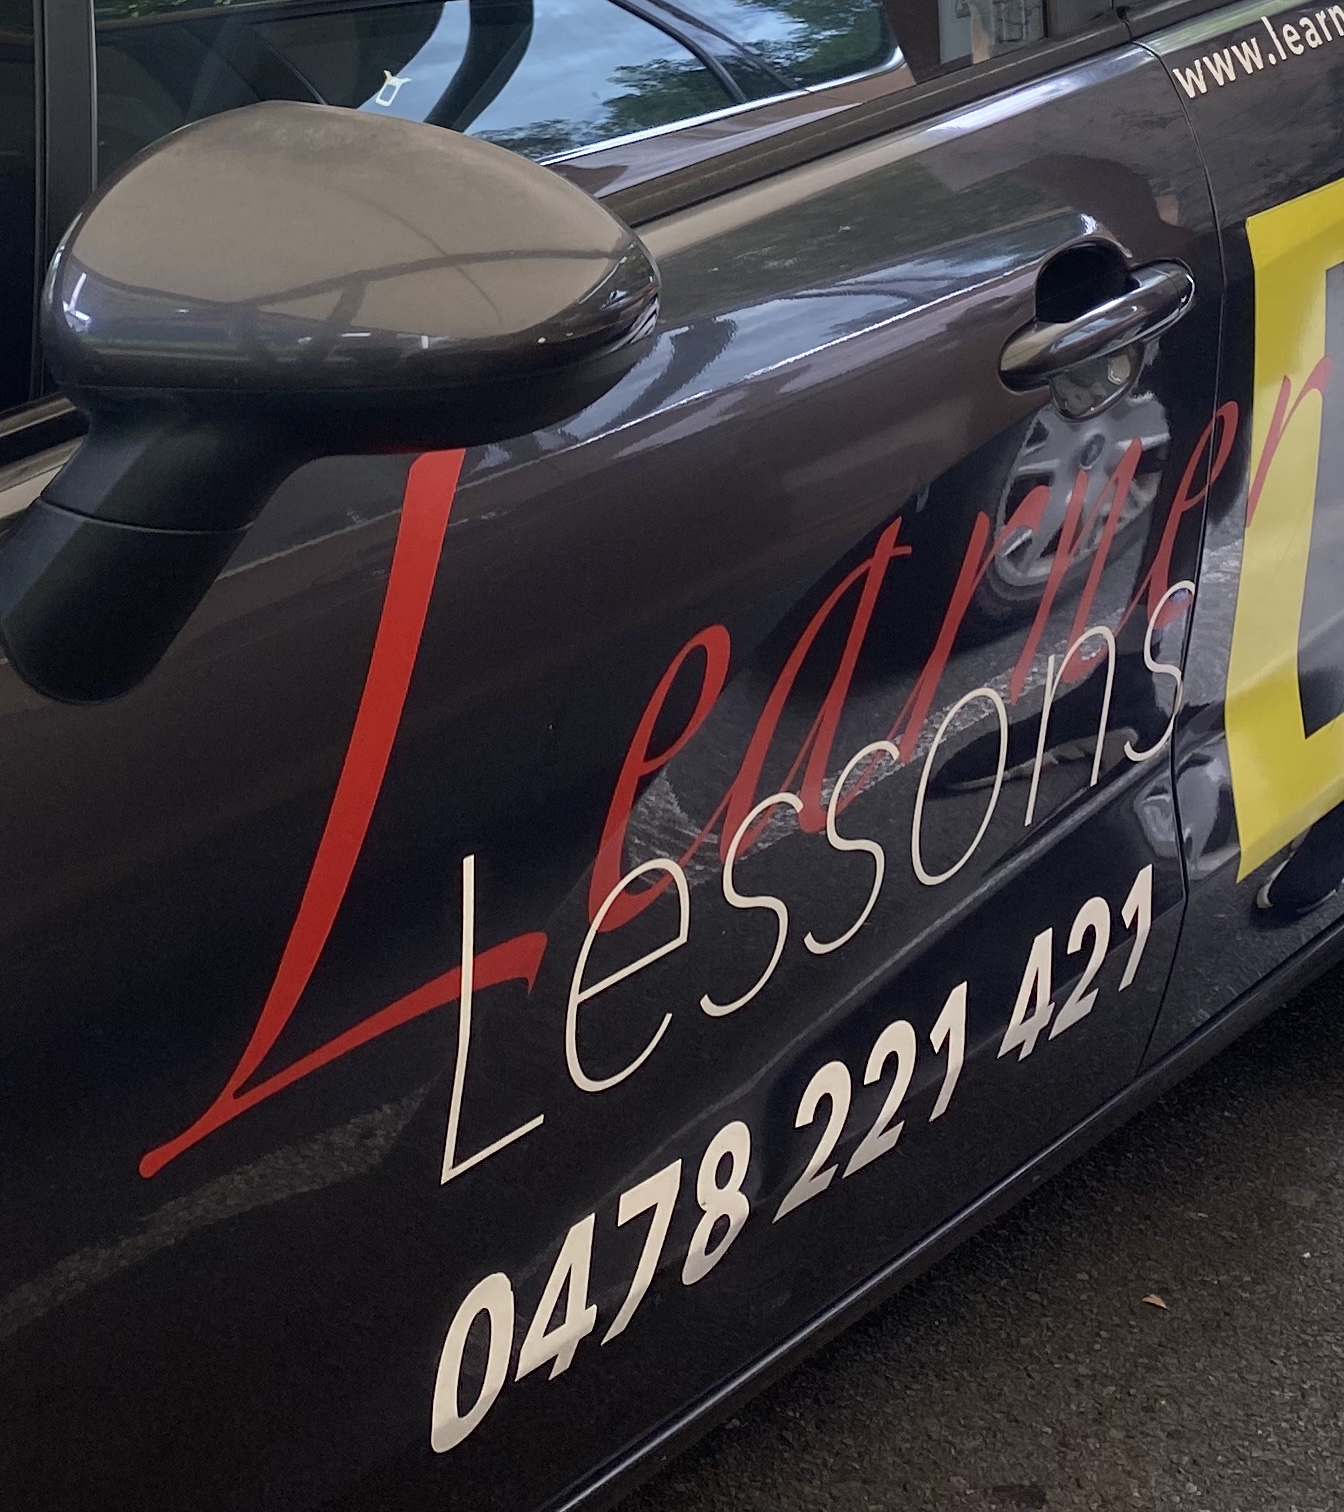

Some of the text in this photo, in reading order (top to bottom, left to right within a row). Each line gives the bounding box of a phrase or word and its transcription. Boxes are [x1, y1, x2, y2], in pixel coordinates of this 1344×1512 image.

[139, 354, 1335, 1178] Learner
[441, 579, 1196, 1185] Lessons
[430, 864, 1153, 1454] 0478 221 421
